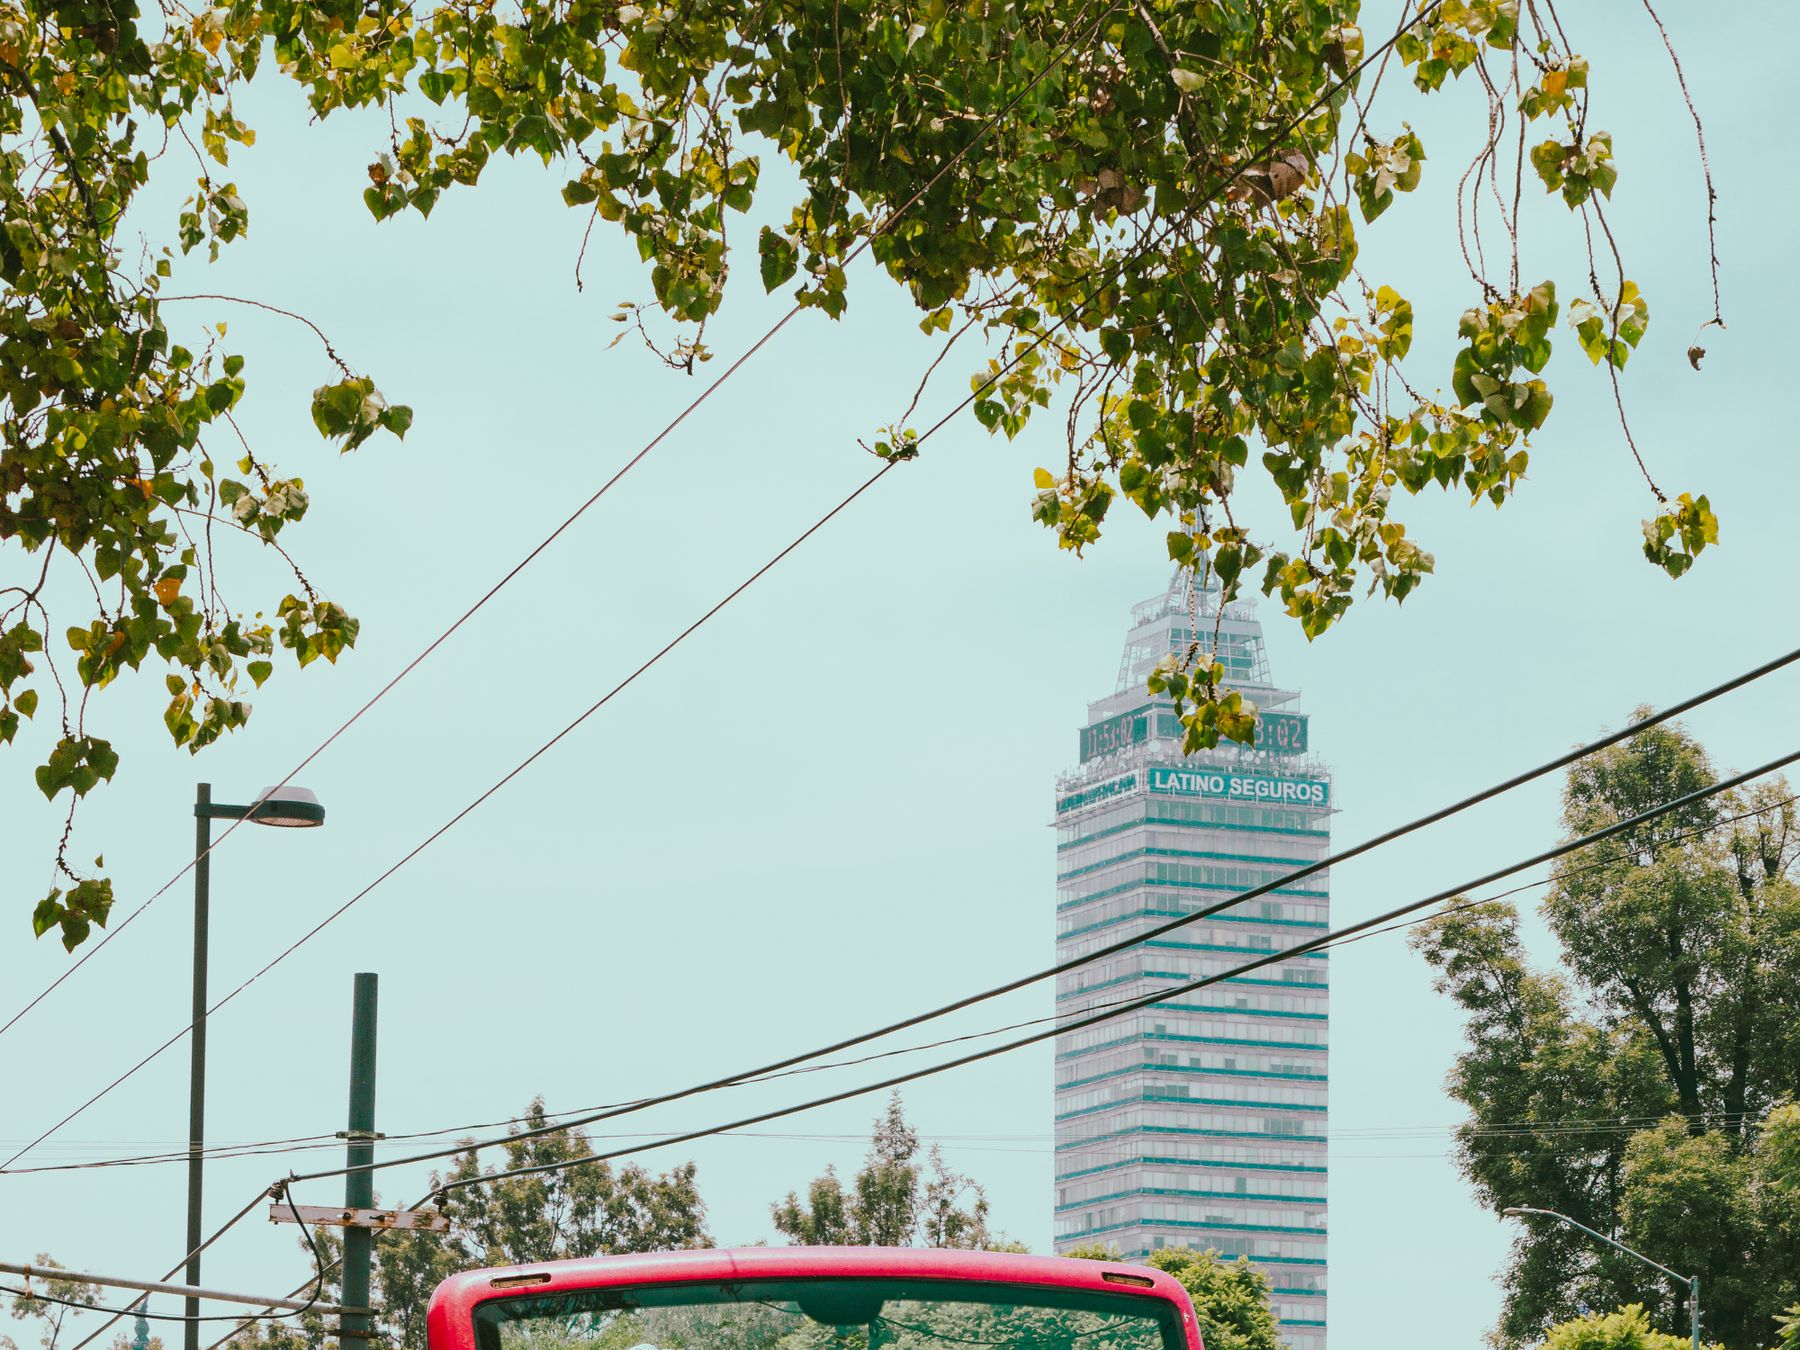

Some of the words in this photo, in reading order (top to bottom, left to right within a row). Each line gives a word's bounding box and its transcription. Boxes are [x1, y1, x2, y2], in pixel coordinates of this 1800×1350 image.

[1087, 716, 1134, 758] 11:53:02
[1254, 717, 1301, 748] 3:02
[1155, 772, 1225, 793] LATINO
[1230, 778, 1324, 801] SEGUROS
